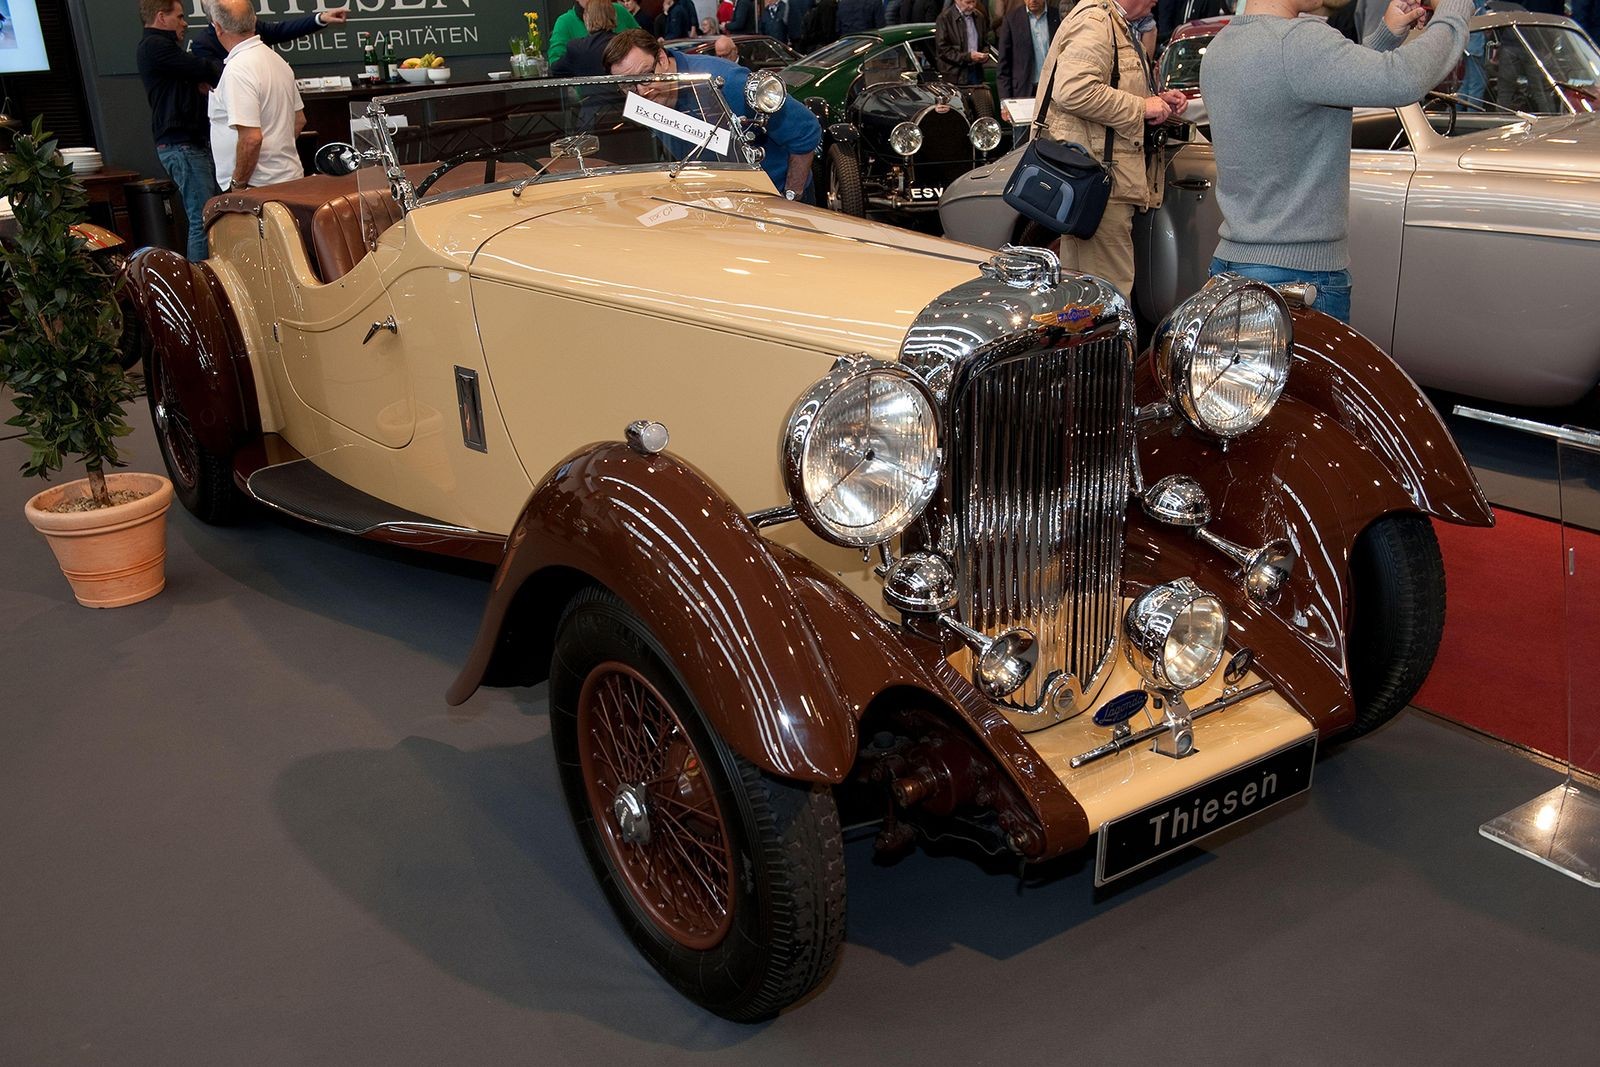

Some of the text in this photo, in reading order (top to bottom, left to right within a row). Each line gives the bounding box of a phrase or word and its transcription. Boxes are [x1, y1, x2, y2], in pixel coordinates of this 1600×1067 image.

[634, 104, 720, 144] Ex Clark Gabl!
[910, 187, 944, 199] ESV
[1149, 772, 1278, 847] Thiesen
